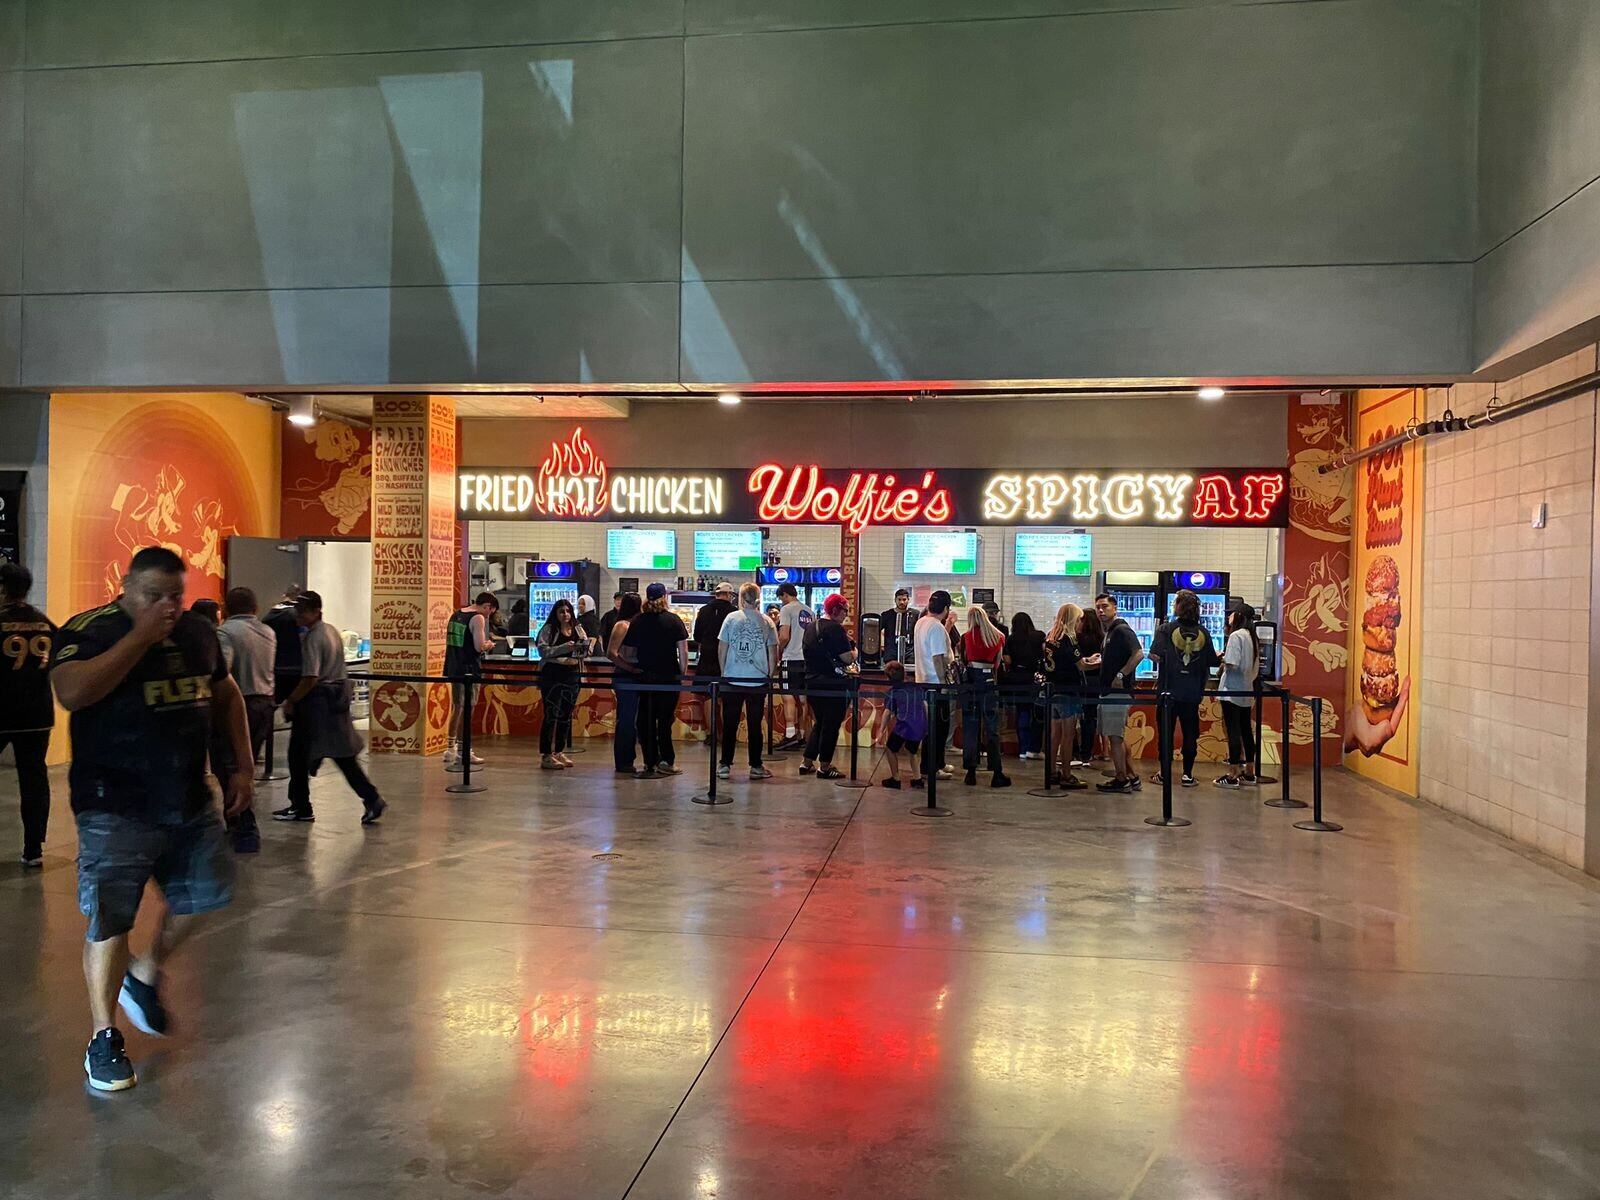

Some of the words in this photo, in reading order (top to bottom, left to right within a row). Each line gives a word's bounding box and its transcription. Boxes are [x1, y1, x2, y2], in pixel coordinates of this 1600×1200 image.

[376, 401, 424, 412] 100%
[376, 427, 424, 441] FRIED
[375, 442, 424, 457] CHICKEN
[375, 458, 424, 472] SANDWICHES
[459, 475, 534, 513] FRIED
[547, 476, 599, 513] HOT
[611, 476, 723, 514] CHICKEN
[749, 464, 950, 533] Wolfie's
[984, 474, 1193, 520] SPICY
[1192, 475, 1284, 519] AF
[374, 543, 423, 559] CHICKEN
[374, 560, 423, 576] TENDERS
[374, 600, 395, 613] HOME
[408, 602, 422, 613] THE
[382, 608, 415, 620] Black
[373, 620, 395, 630] and
[396, 618, 422, 634] Gold
[373, 631, 422, 640] BURGER
[2, 635, 52, 670] 99
[739, 641, 750, 651] LA
[373, 650, 400, 659] Street
[400, 650, 422, 660] Corn
[373, 662, 394, 671] CLASSIC
[404, 662, 422, 671] FUEGO
[372, 736, 420, 748] 100%
